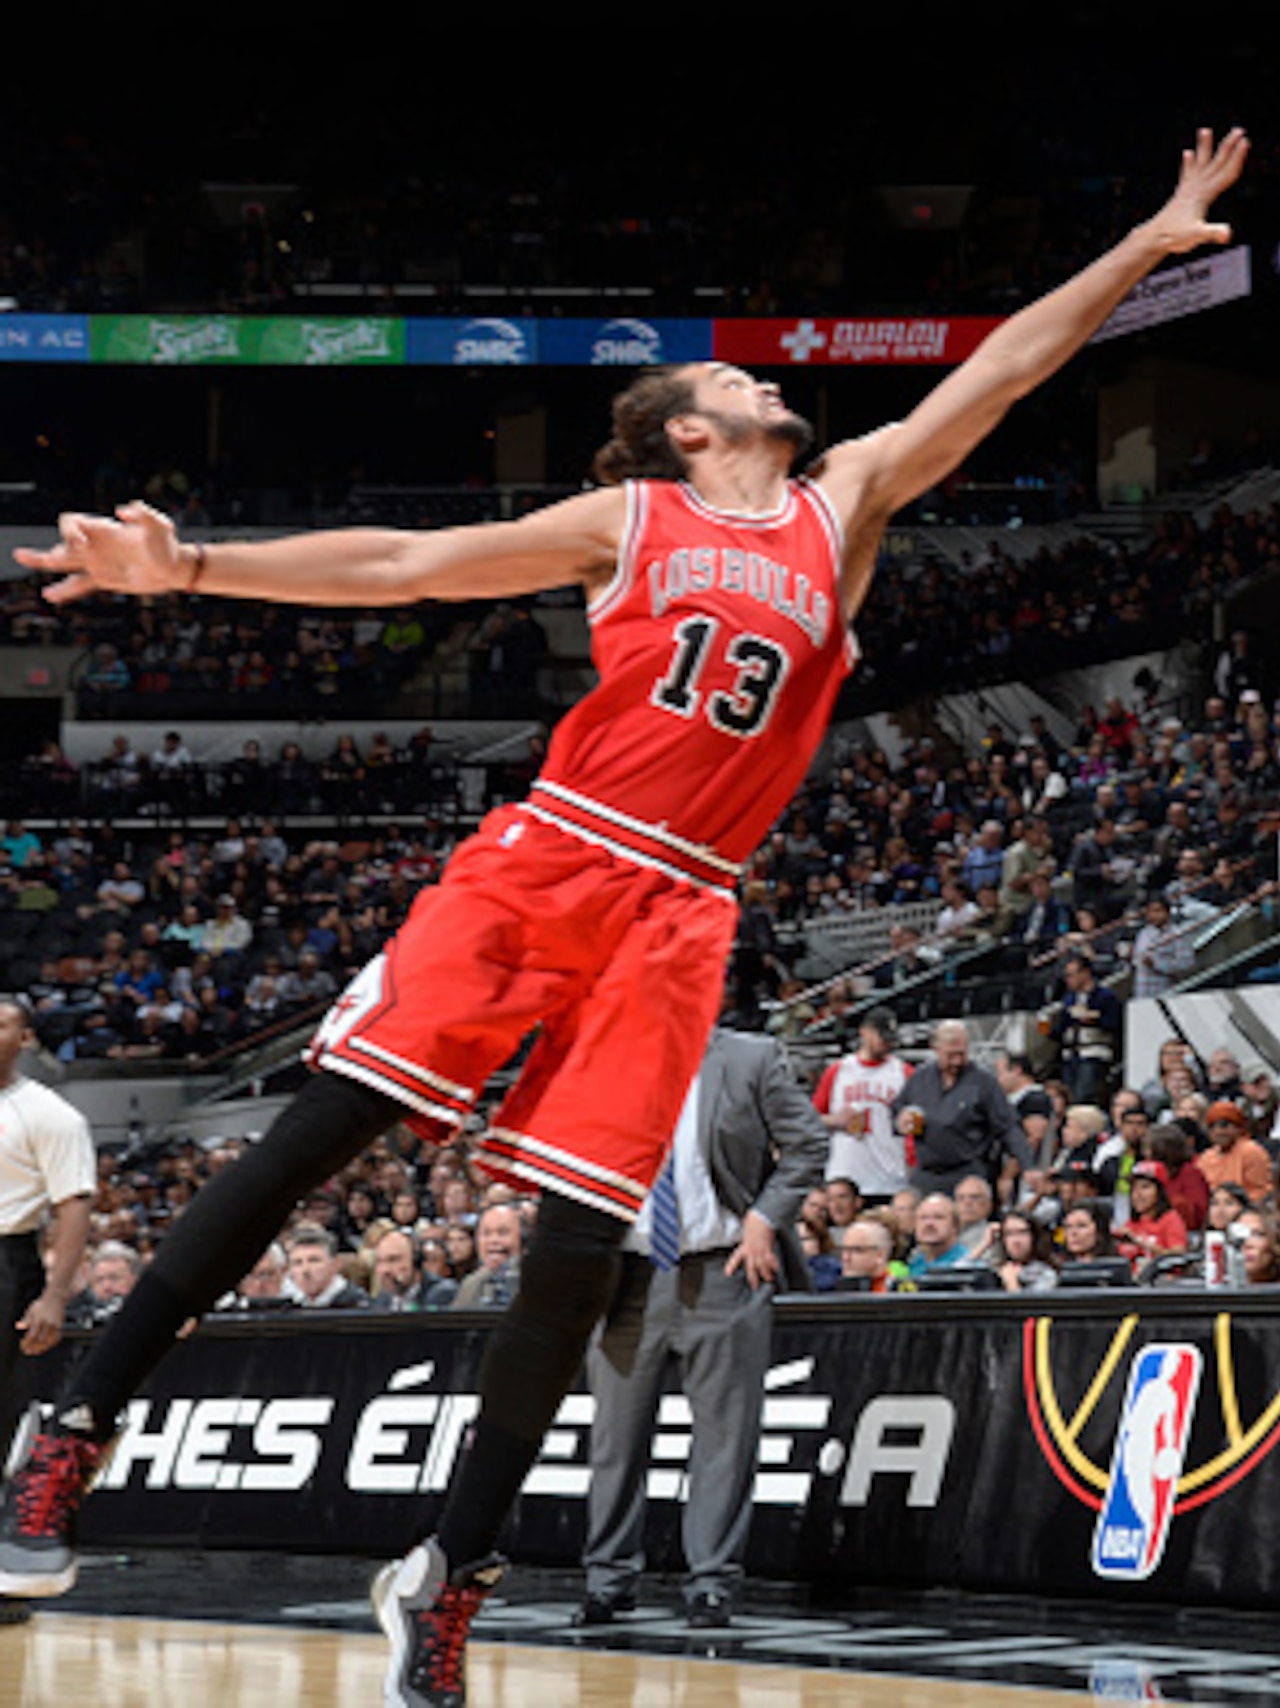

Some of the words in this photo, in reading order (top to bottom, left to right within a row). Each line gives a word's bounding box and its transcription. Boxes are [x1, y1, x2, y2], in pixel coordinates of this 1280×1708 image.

[648, 547, 717, 617] LOS
[720, 547, 829, 649] BULLS
[648, 612, 792, 738] 13
[1101, 1525, 1143, 1560] NBA
